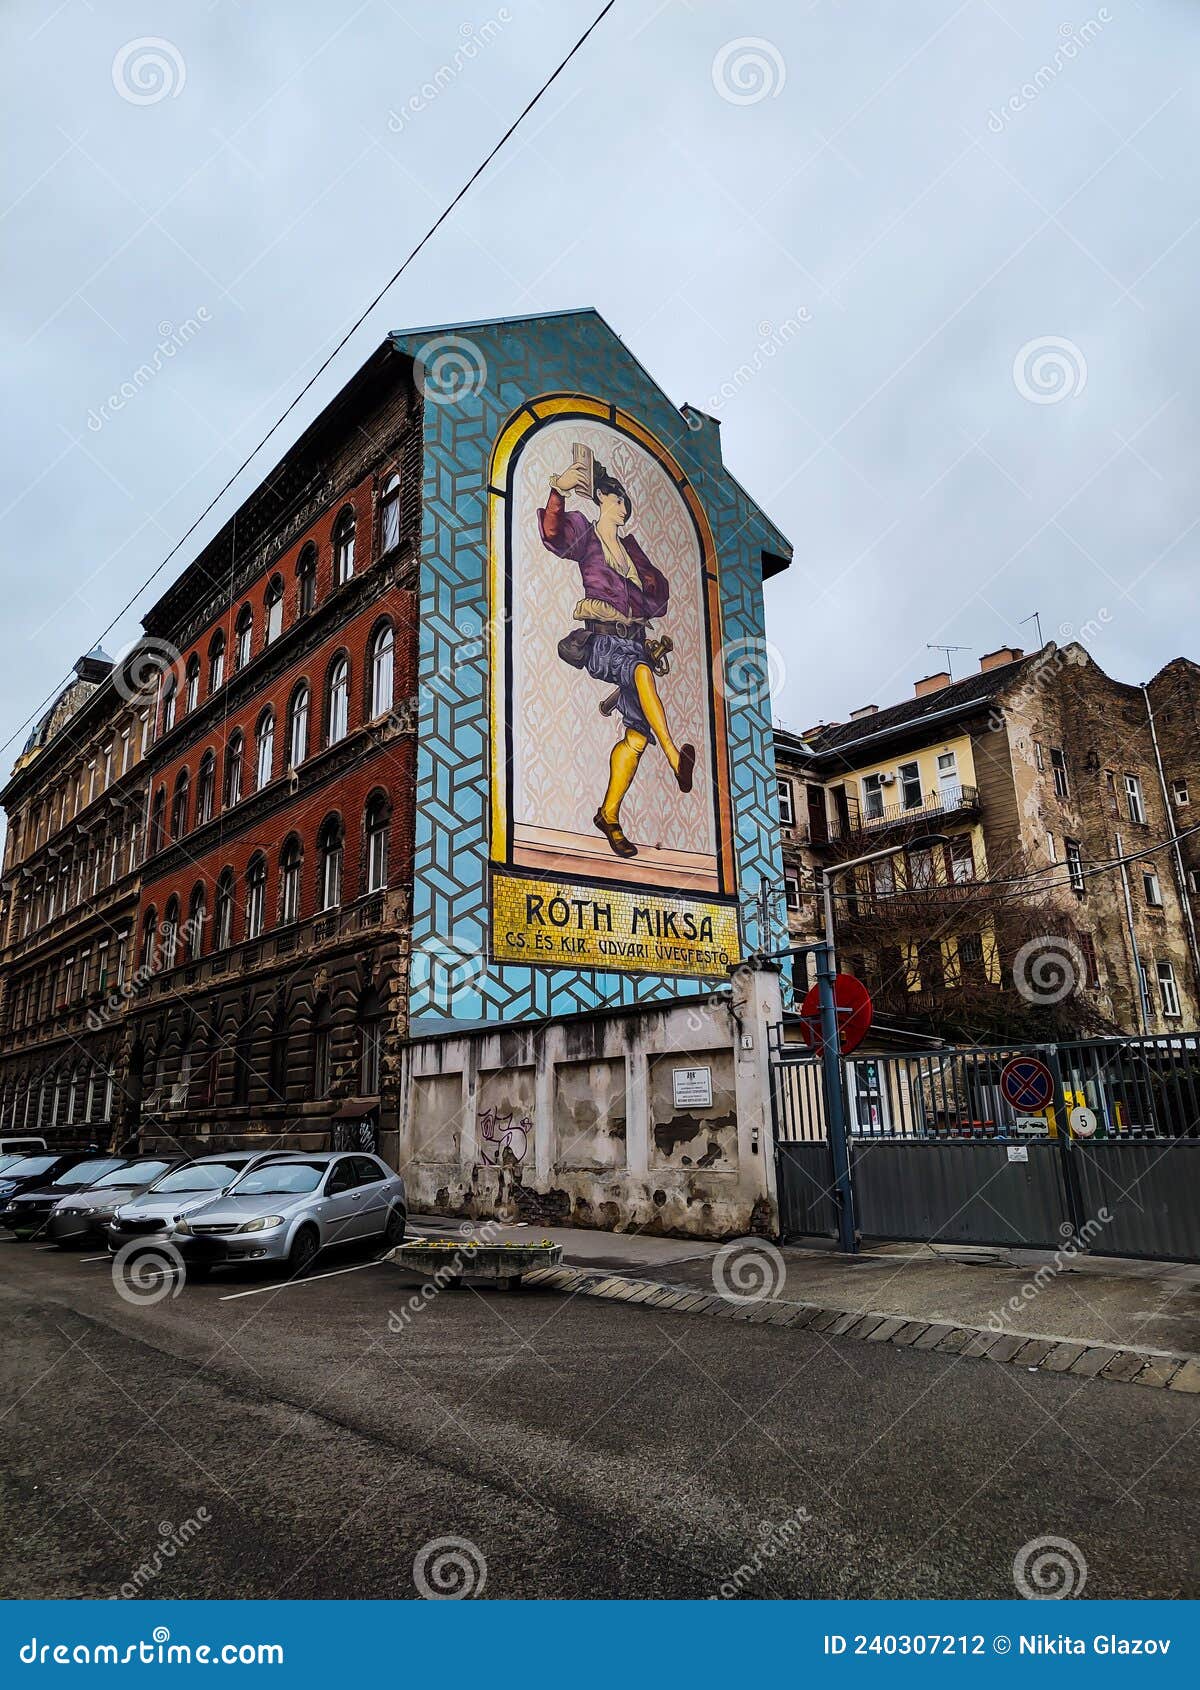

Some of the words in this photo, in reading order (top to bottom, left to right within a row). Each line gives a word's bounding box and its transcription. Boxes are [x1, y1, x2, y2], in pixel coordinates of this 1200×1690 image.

[526, 891, 612, 932] RÓTH
[632, 907, 713, 942] MIKSA
[506, 931, 530, 948] CS.
[535, 930, 553, 950] ÉS
[561, 936, 591, 953] KIR.
[599, 940, 649, 958] UDVARI
[1079, 1115, 1088, 1128] 5
